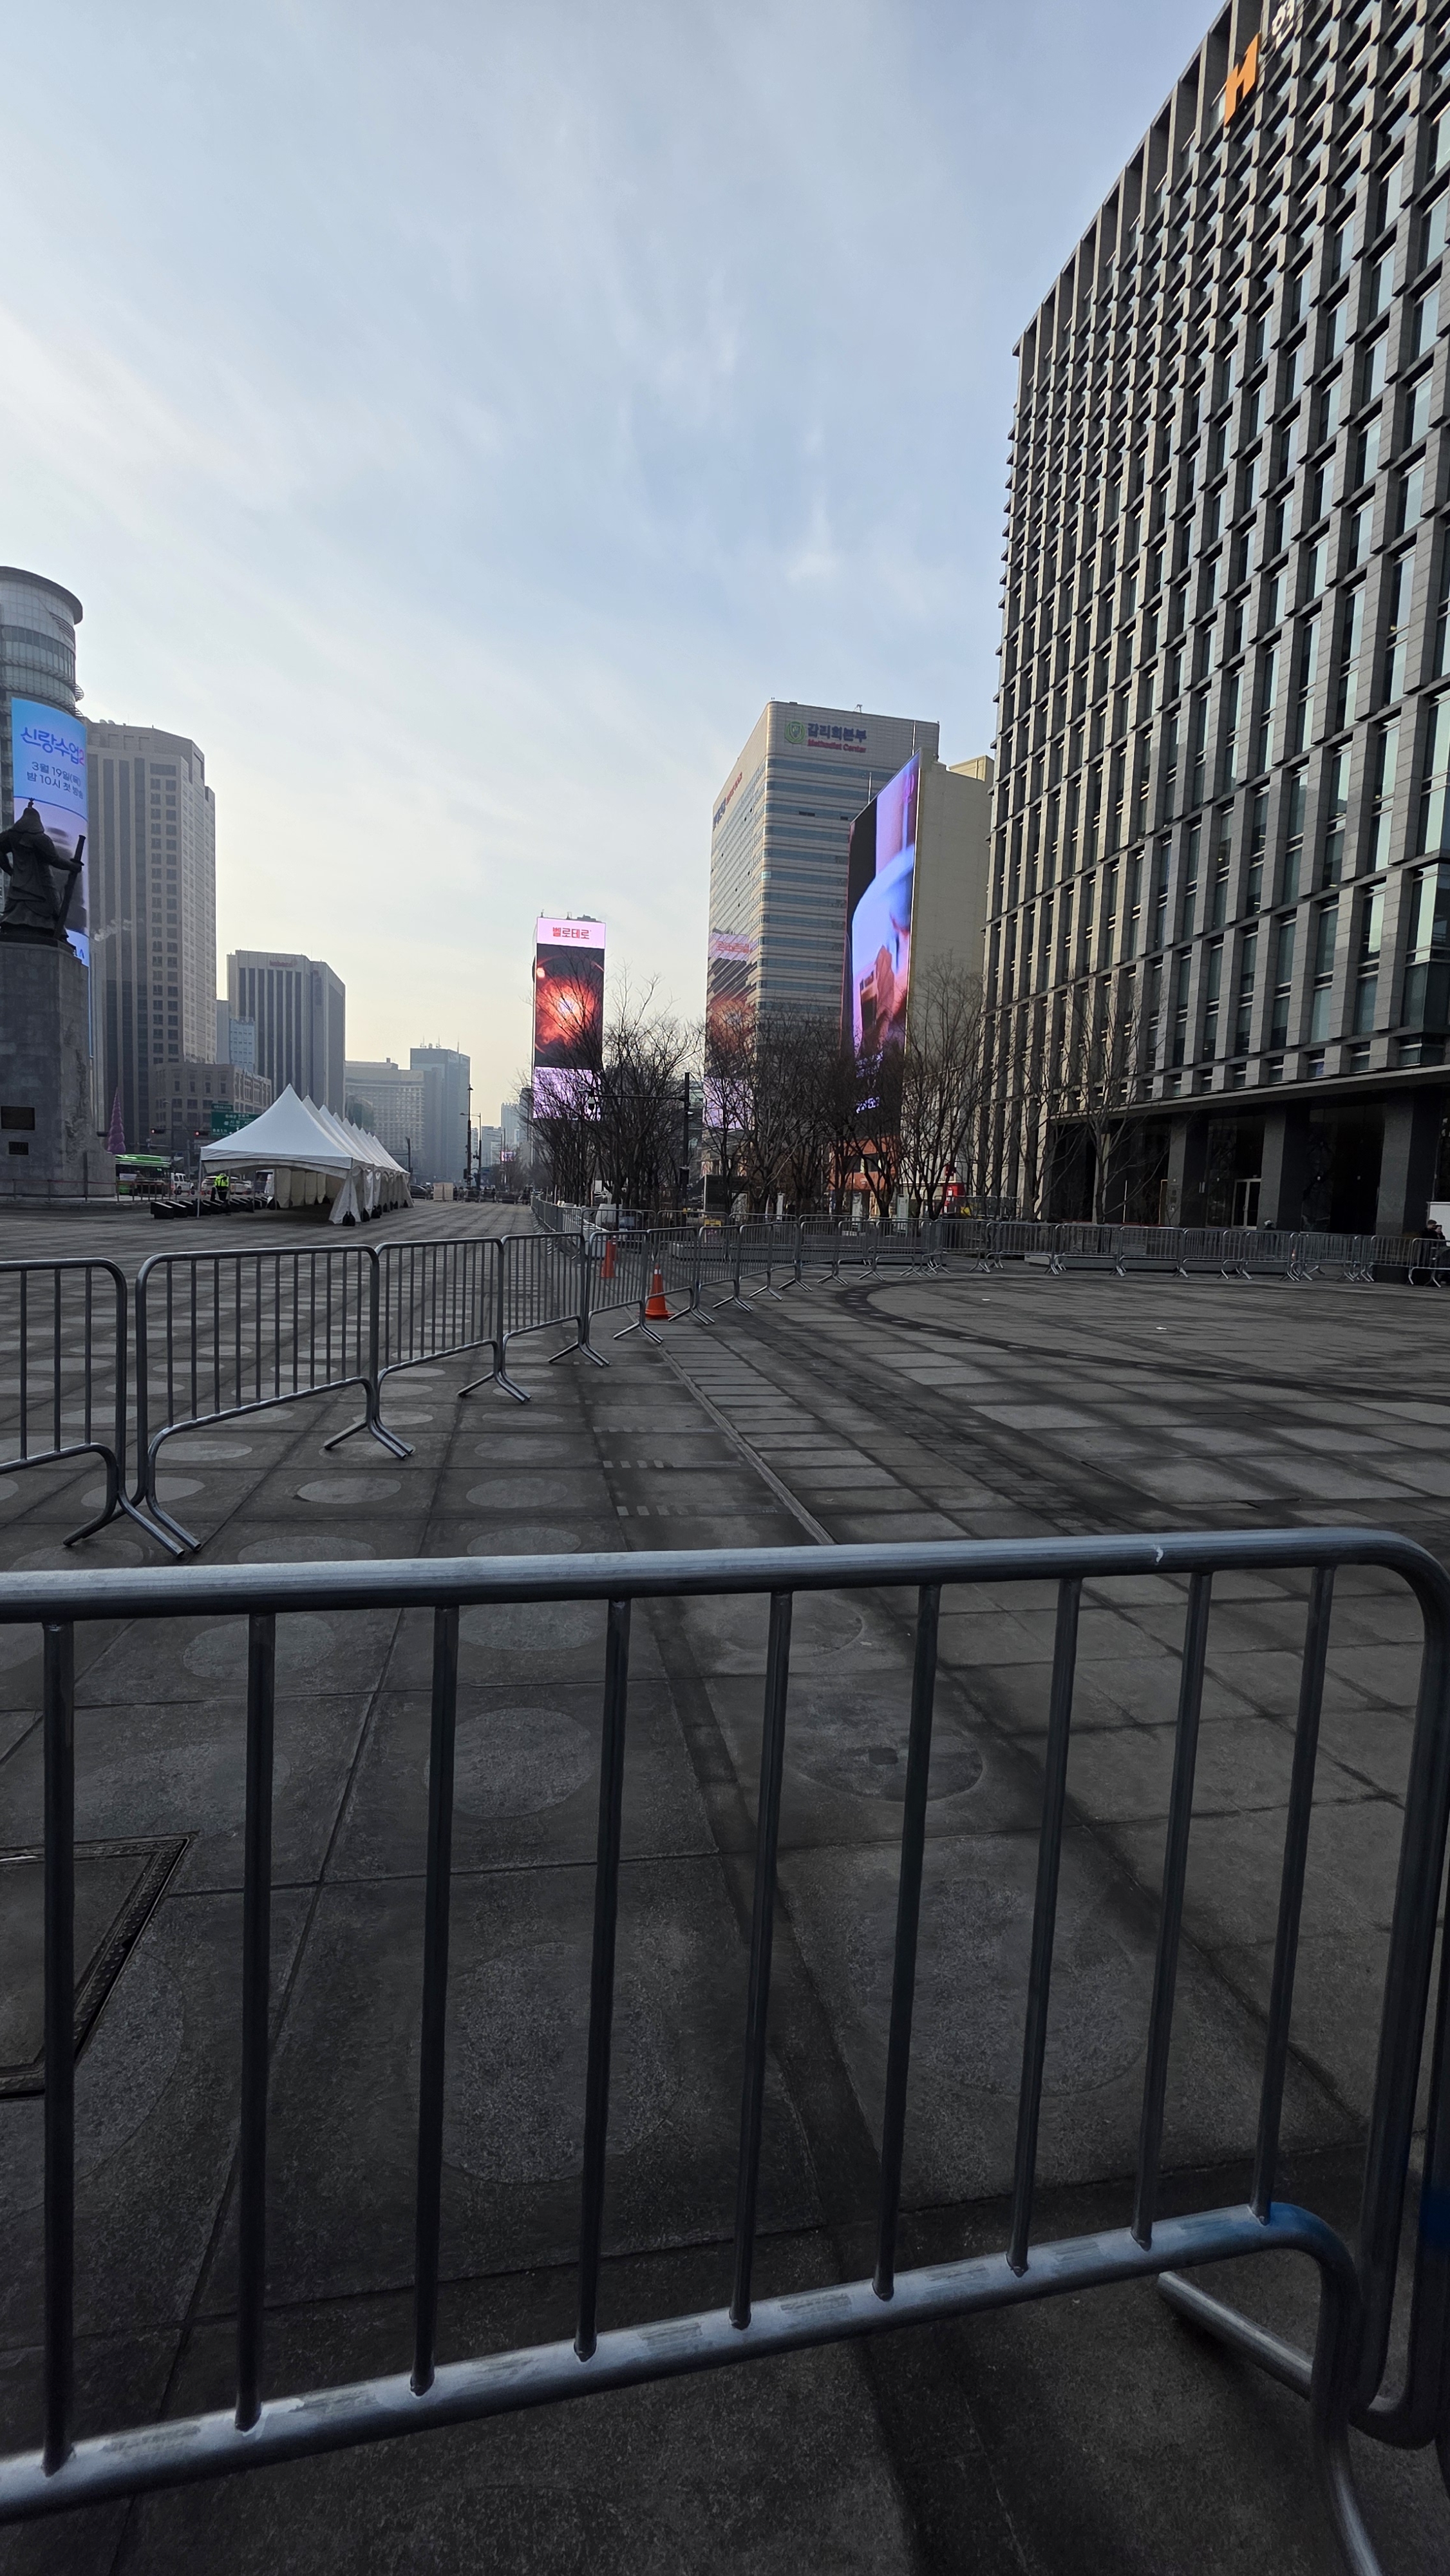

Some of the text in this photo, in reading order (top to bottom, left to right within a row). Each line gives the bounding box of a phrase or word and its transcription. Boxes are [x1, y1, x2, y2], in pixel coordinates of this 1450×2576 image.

[807, 723, 867, 743] 감리회본부
[21, 726, 85, 766] 신랑수업2
[32, 761, 49, 773] 3월
[27, 772, 37, 782] 밤
[40, 774, 61, 789] 10시
[63, 782, 71, 793] 첫
